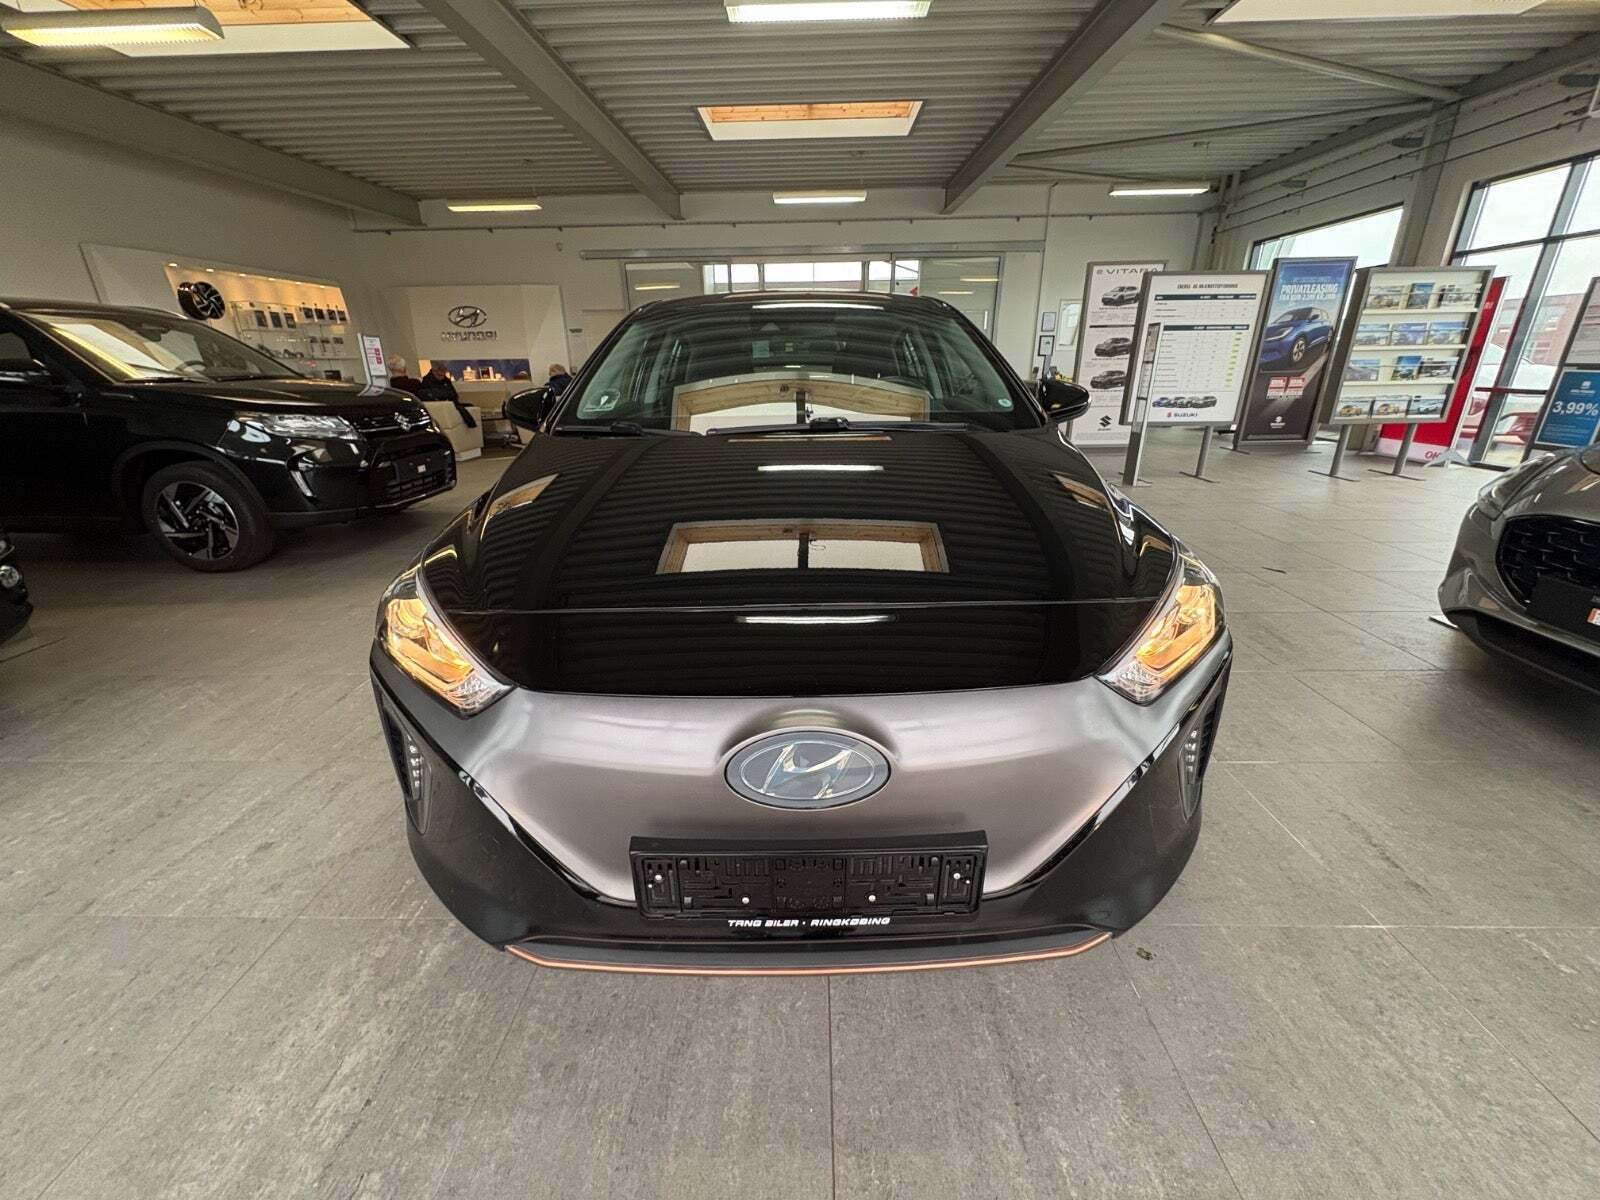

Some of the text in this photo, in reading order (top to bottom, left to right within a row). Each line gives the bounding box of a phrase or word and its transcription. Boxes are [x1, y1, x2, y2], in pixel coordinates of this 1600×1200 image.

[1280, 283, 1339, 295] PRIVATLEASING
[441, 330, 498, 342] HYUNDAI
[1552, 401, 1599, 417] 3,99%
